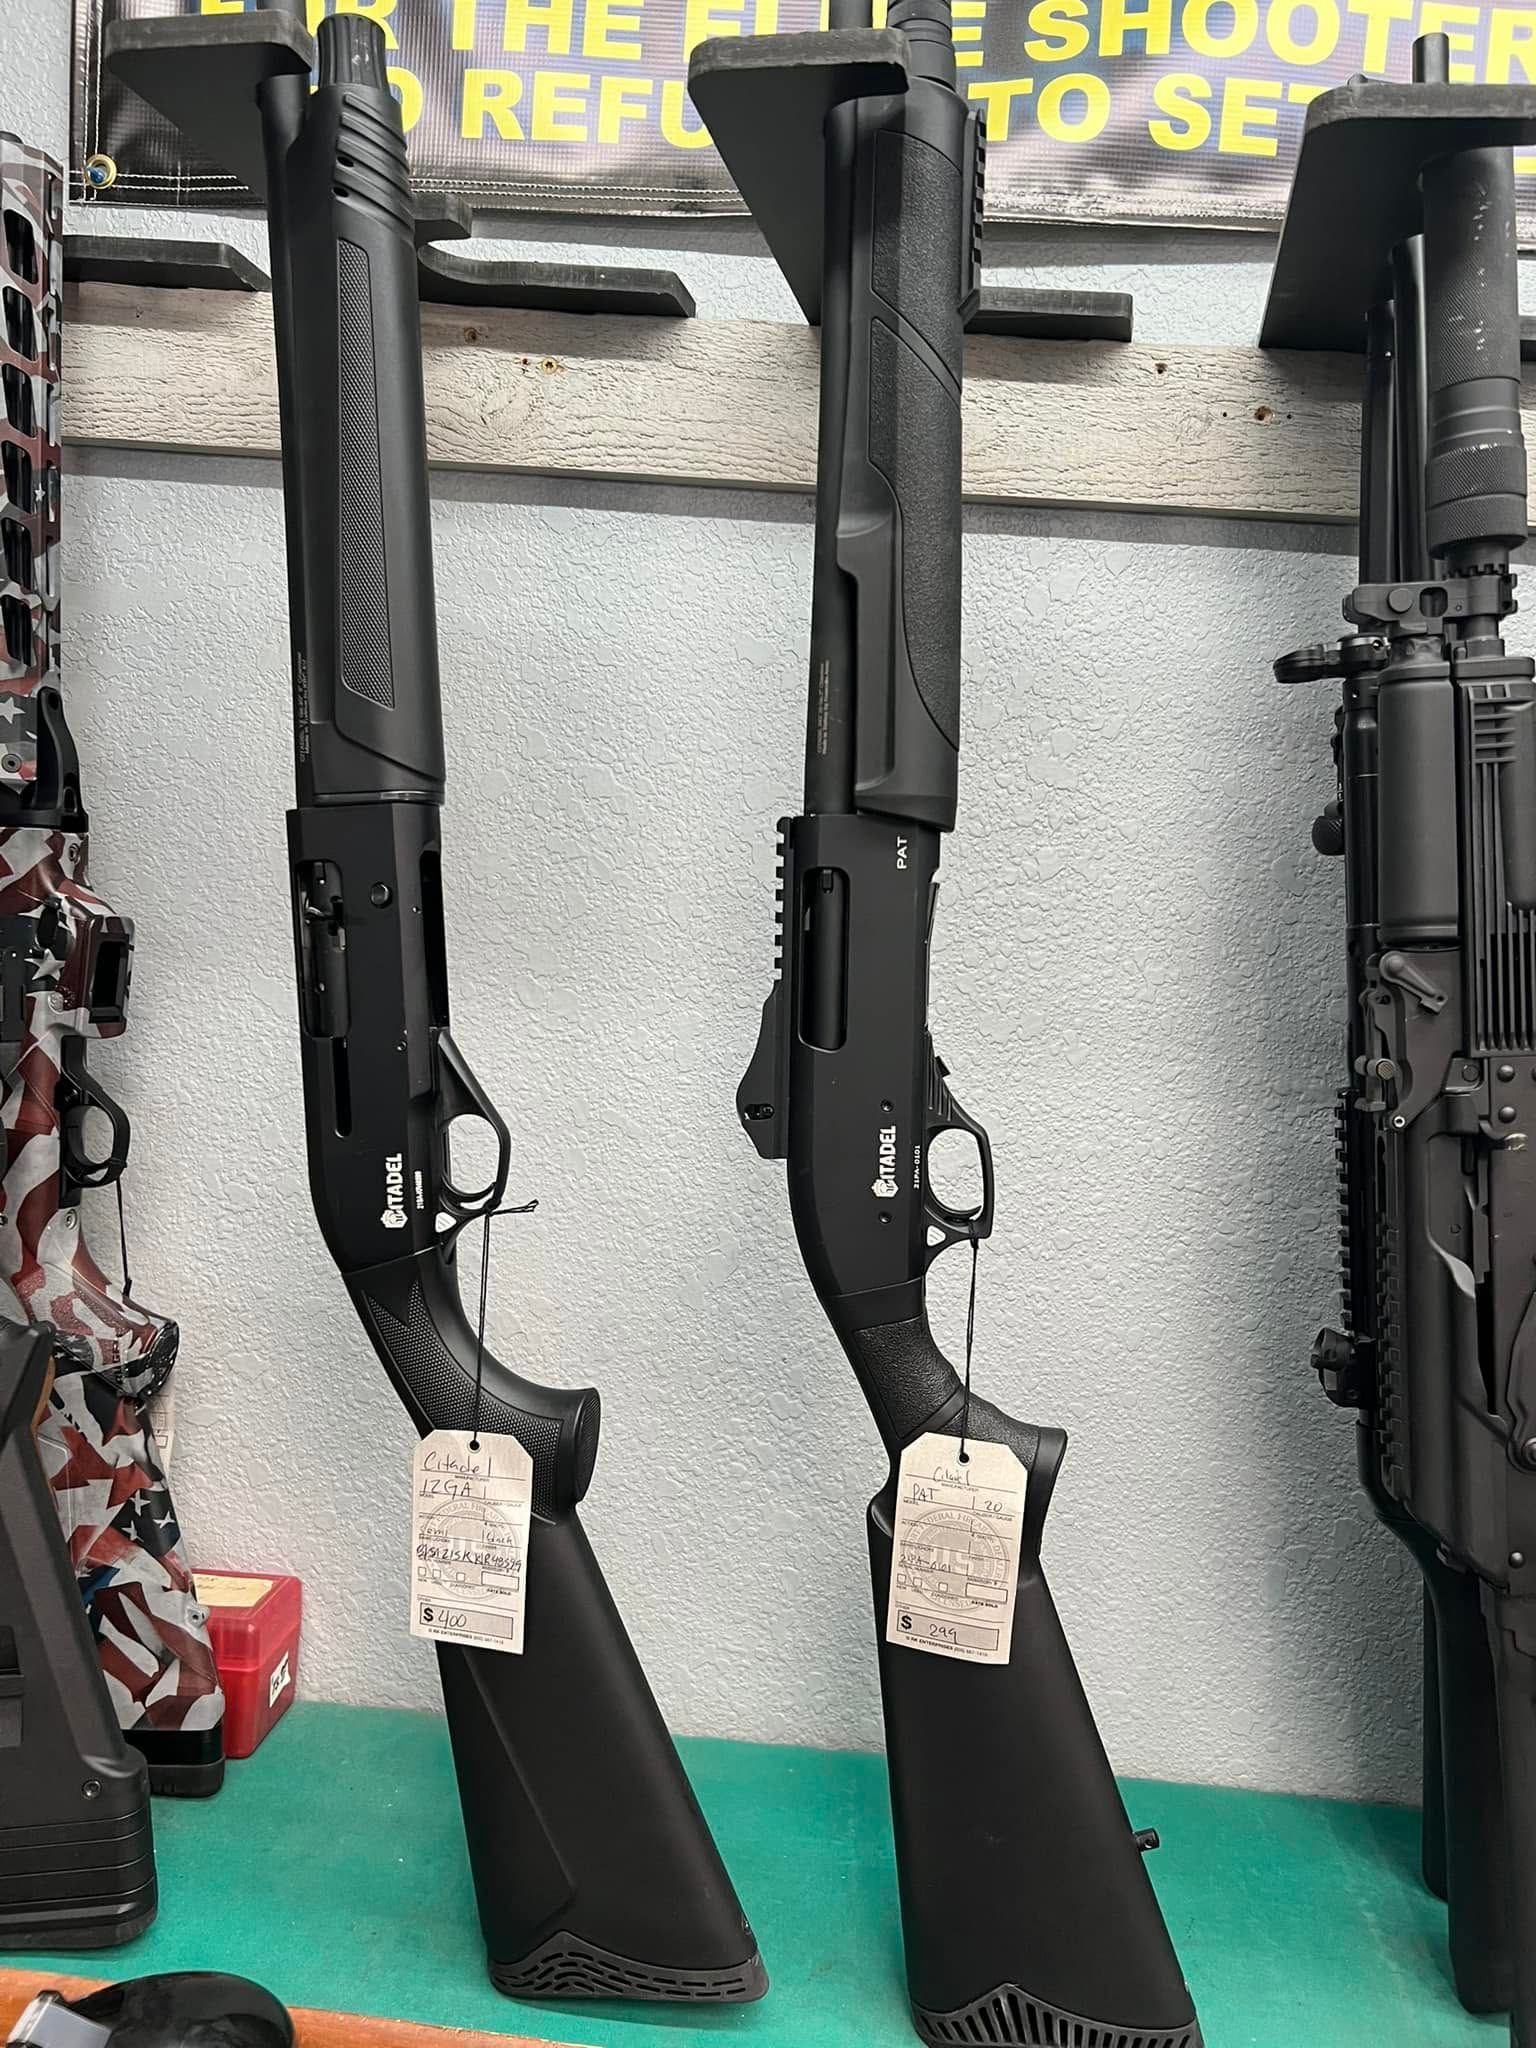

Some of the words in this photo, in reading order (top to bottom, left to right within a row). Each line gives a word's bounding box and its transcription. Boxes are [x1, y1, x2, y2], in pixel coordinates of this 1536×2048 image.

[450, 0, 642, 62] THE
[461, 68, 712, 149] REFU
[967, 72, 1111, 144] TO
[897, 836, 907, 869] PAT
[913, 1482, 940, 1503] PAT
[423, 1606, 434, 1623] $
[438, 1609, 467, 1630] 400
[900, 1614, 912, 1631] $
